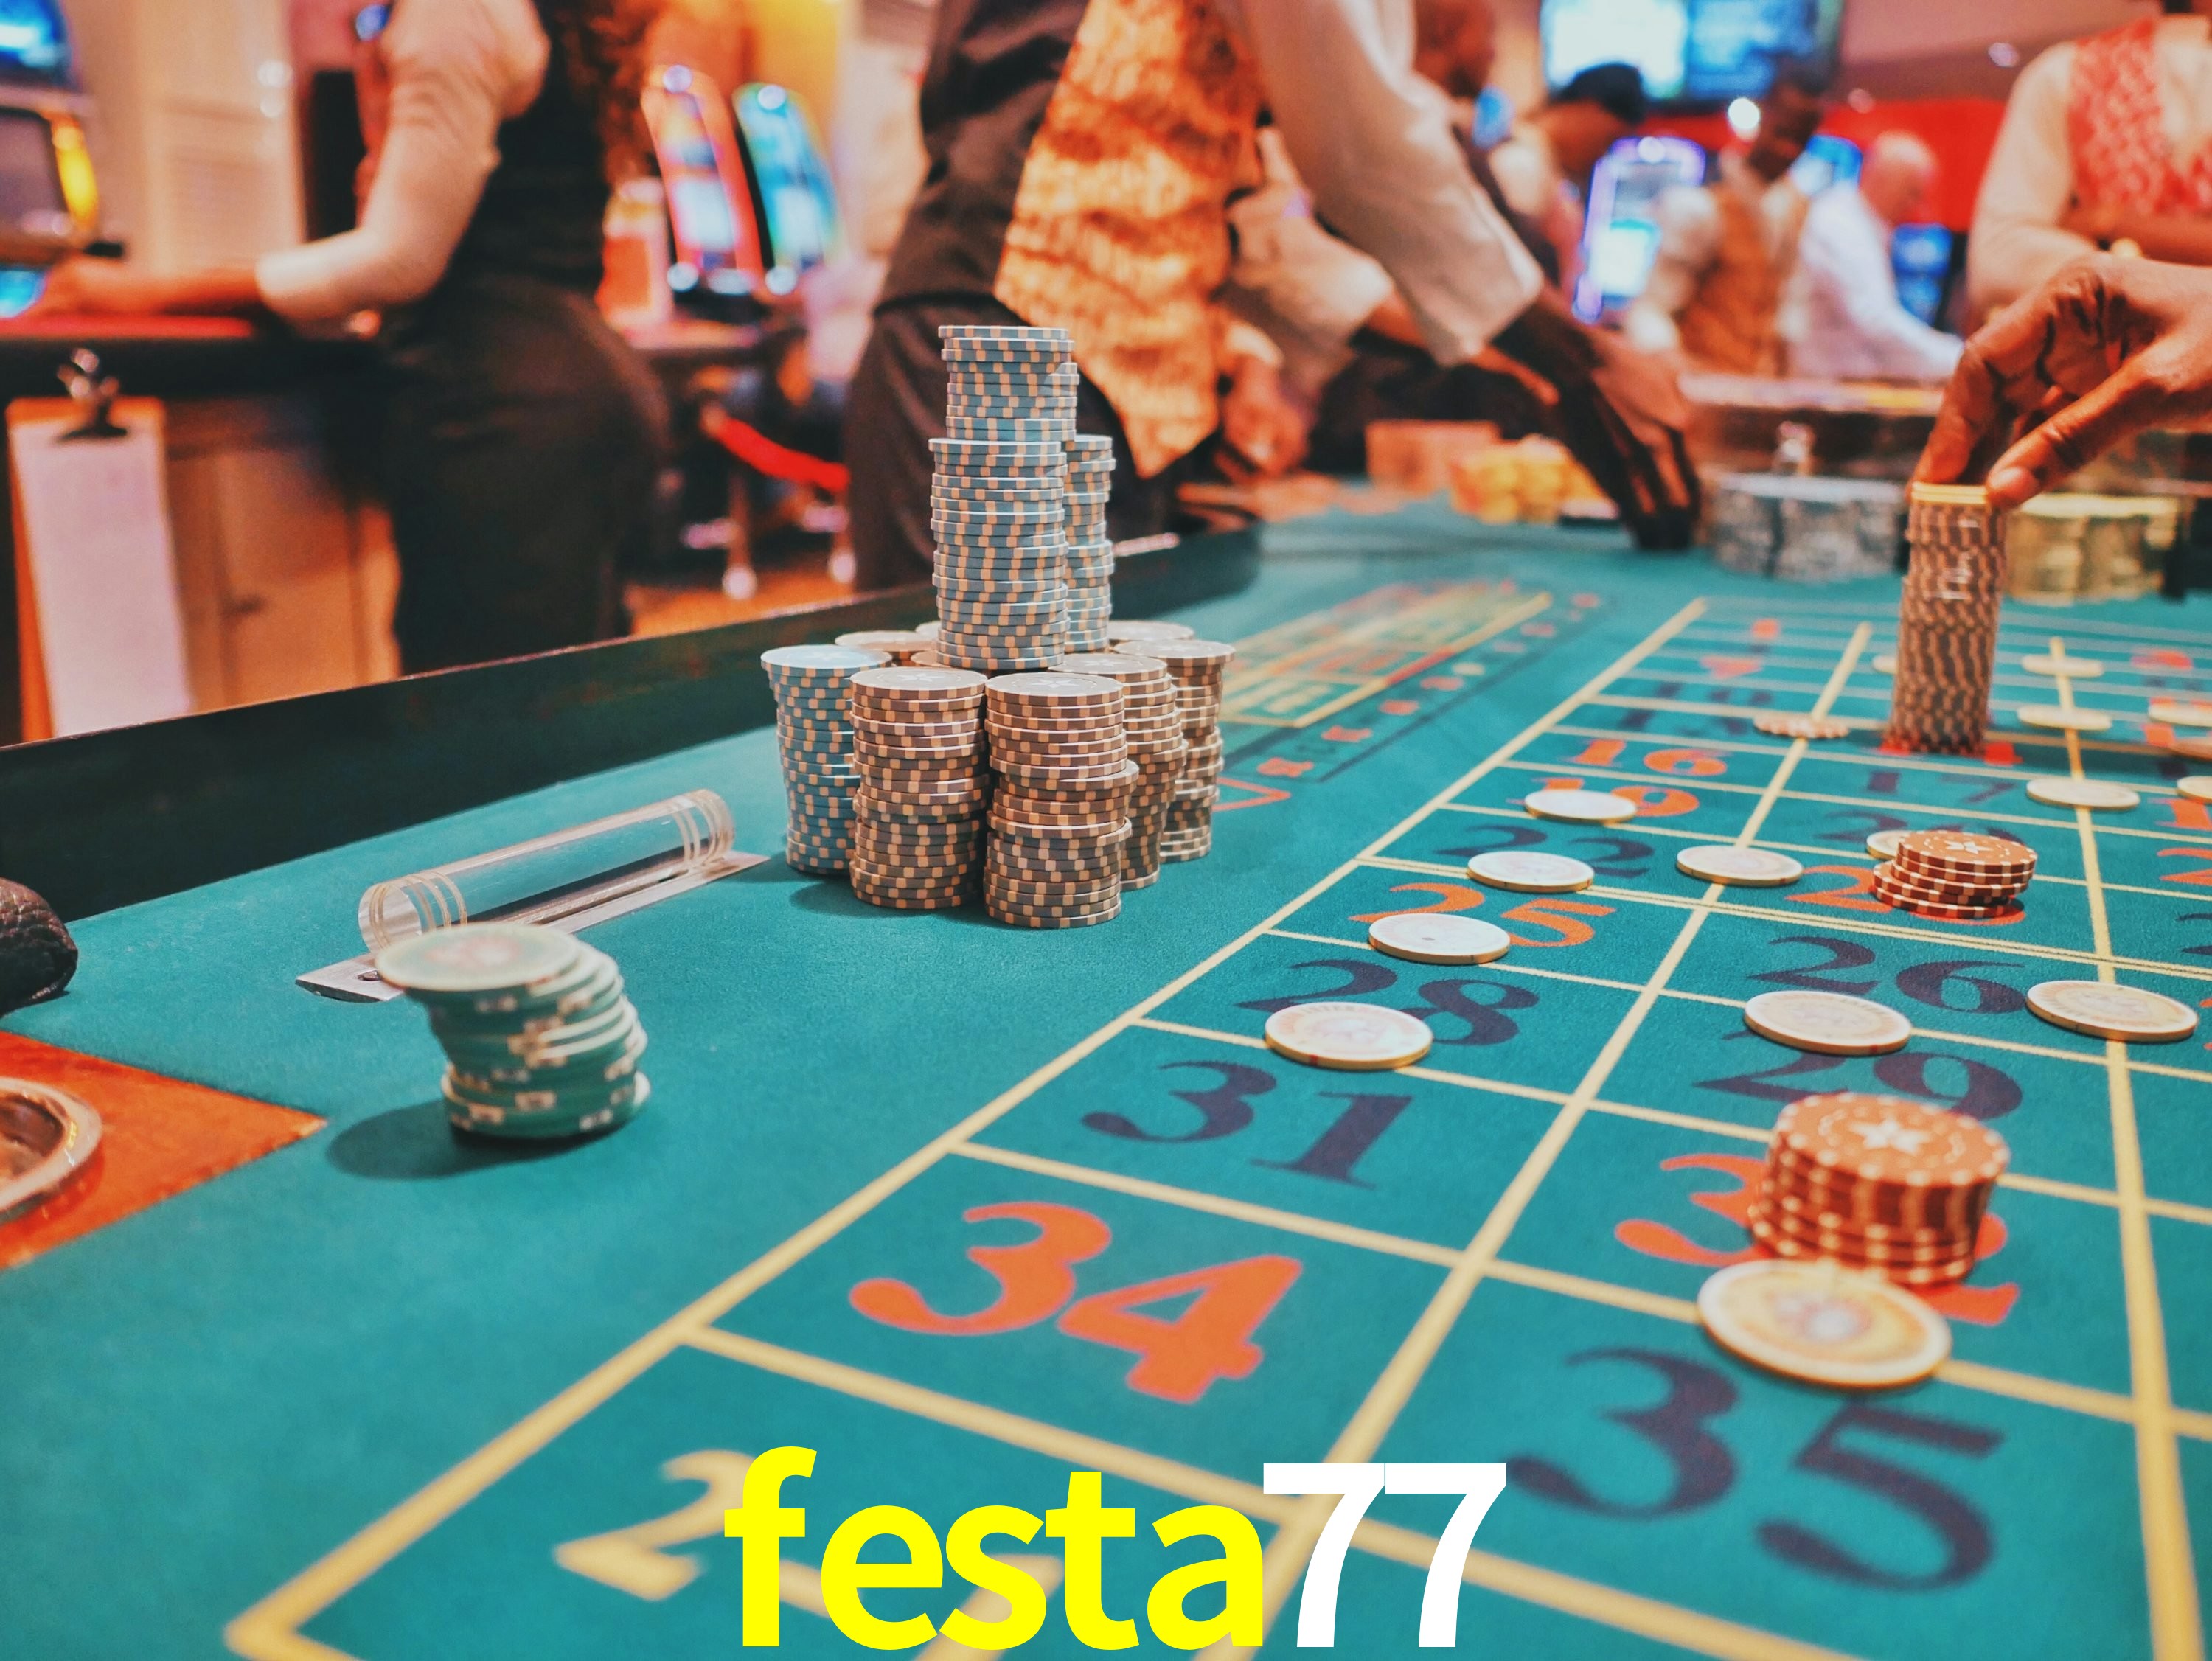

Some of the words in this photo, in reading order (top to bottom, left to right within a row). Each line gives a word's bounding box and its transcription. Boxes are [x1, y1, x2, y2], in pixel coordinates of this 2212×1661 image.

[1557, 737, 1734, 777] 16
[1433, 824, 1655, 879] 22
[1812, 810, 2028, 845] 2
[1349, 882, 1617, 947] 25
[1784, 864, 2028, 926] 2
[1234, 959, 1540, 1045] 28
[1747, 936, 2026, 1014] 26
[1692, 1028, 2023, 1120] 29
[1082, 1060, 1414, 1190] 31
[1615, 1154, 2020, 1326] 3
[849, 1202, 1302, 1404] 34
[1506, 1345, 2004, 1594] 35
